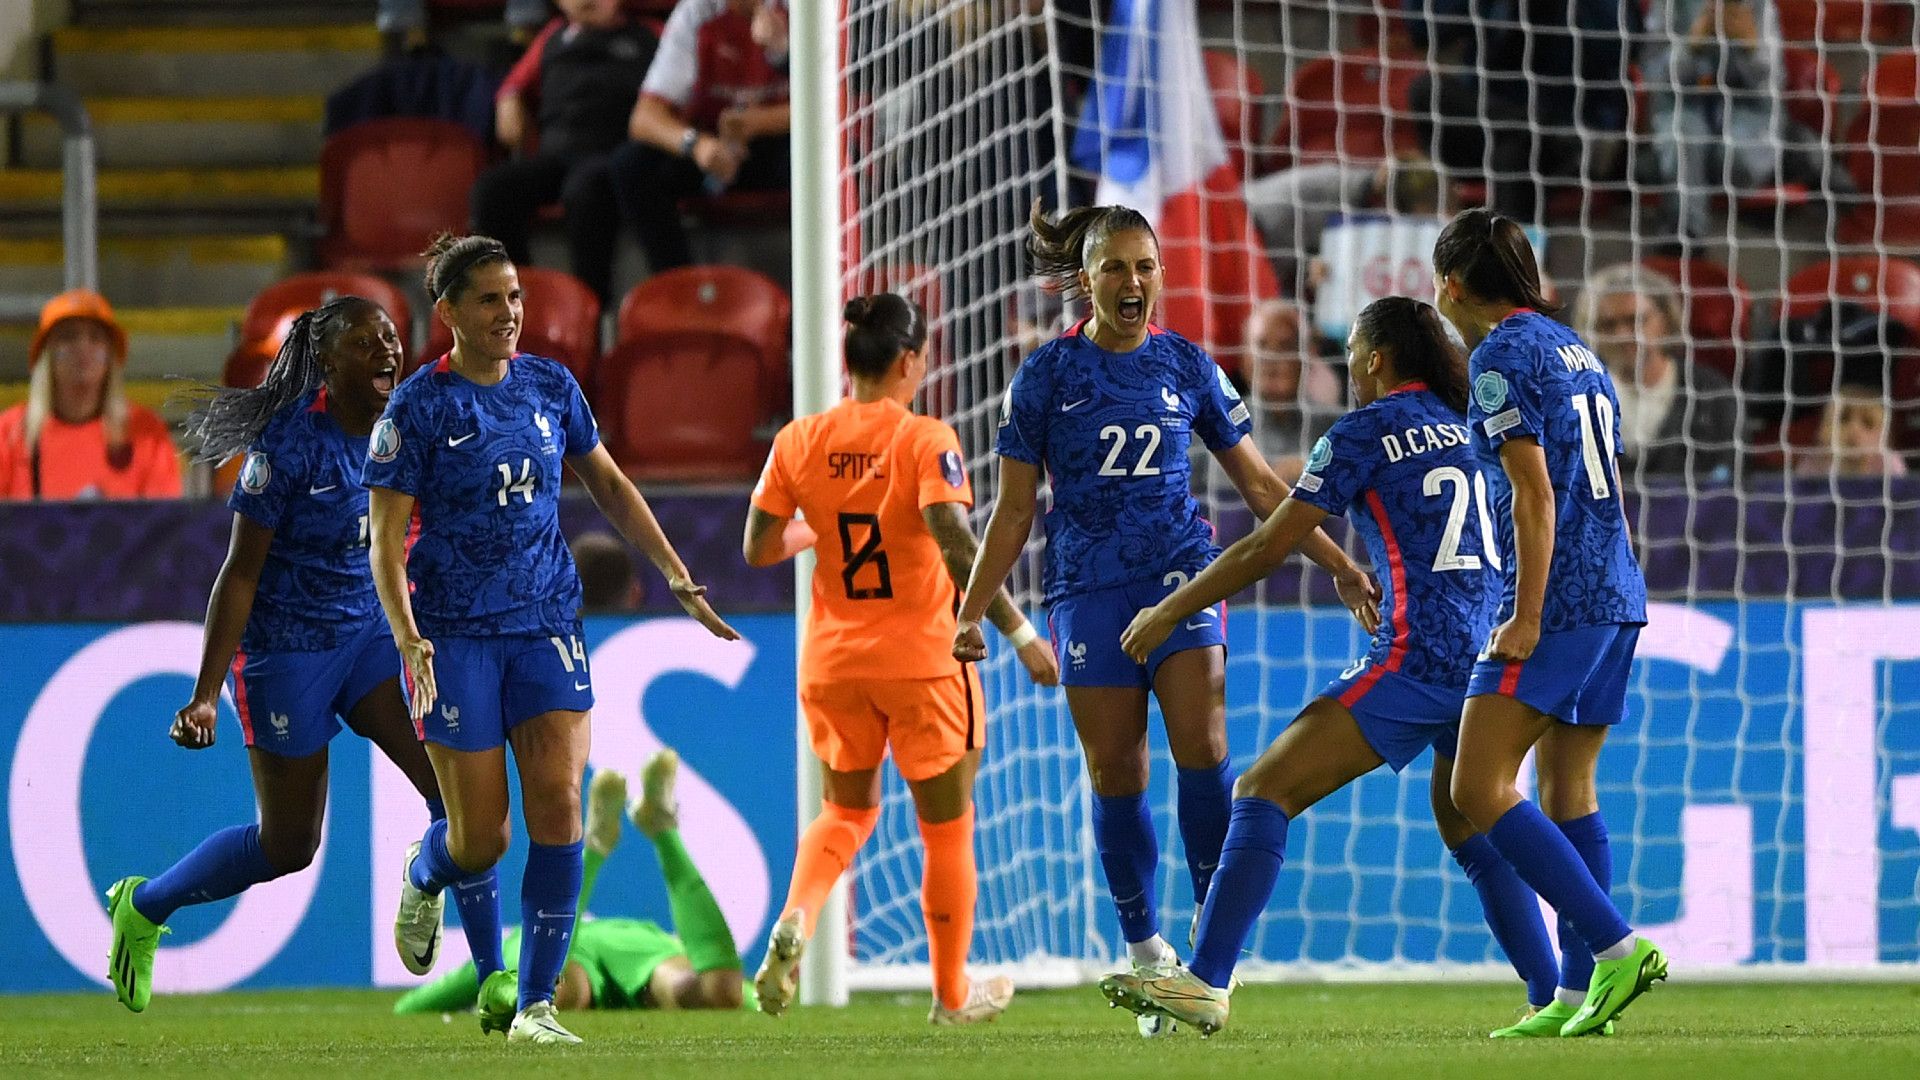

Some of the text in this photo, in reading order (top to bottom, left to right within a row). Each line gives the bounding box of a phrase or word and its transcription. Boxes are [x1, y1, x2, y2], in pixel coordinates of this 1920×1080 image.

[1098, 424, 1161, 475] 22
[498, 458, 535, 506] 14
[838, 512, 893, 599] 8
[550, 635, 588, 673] 14
